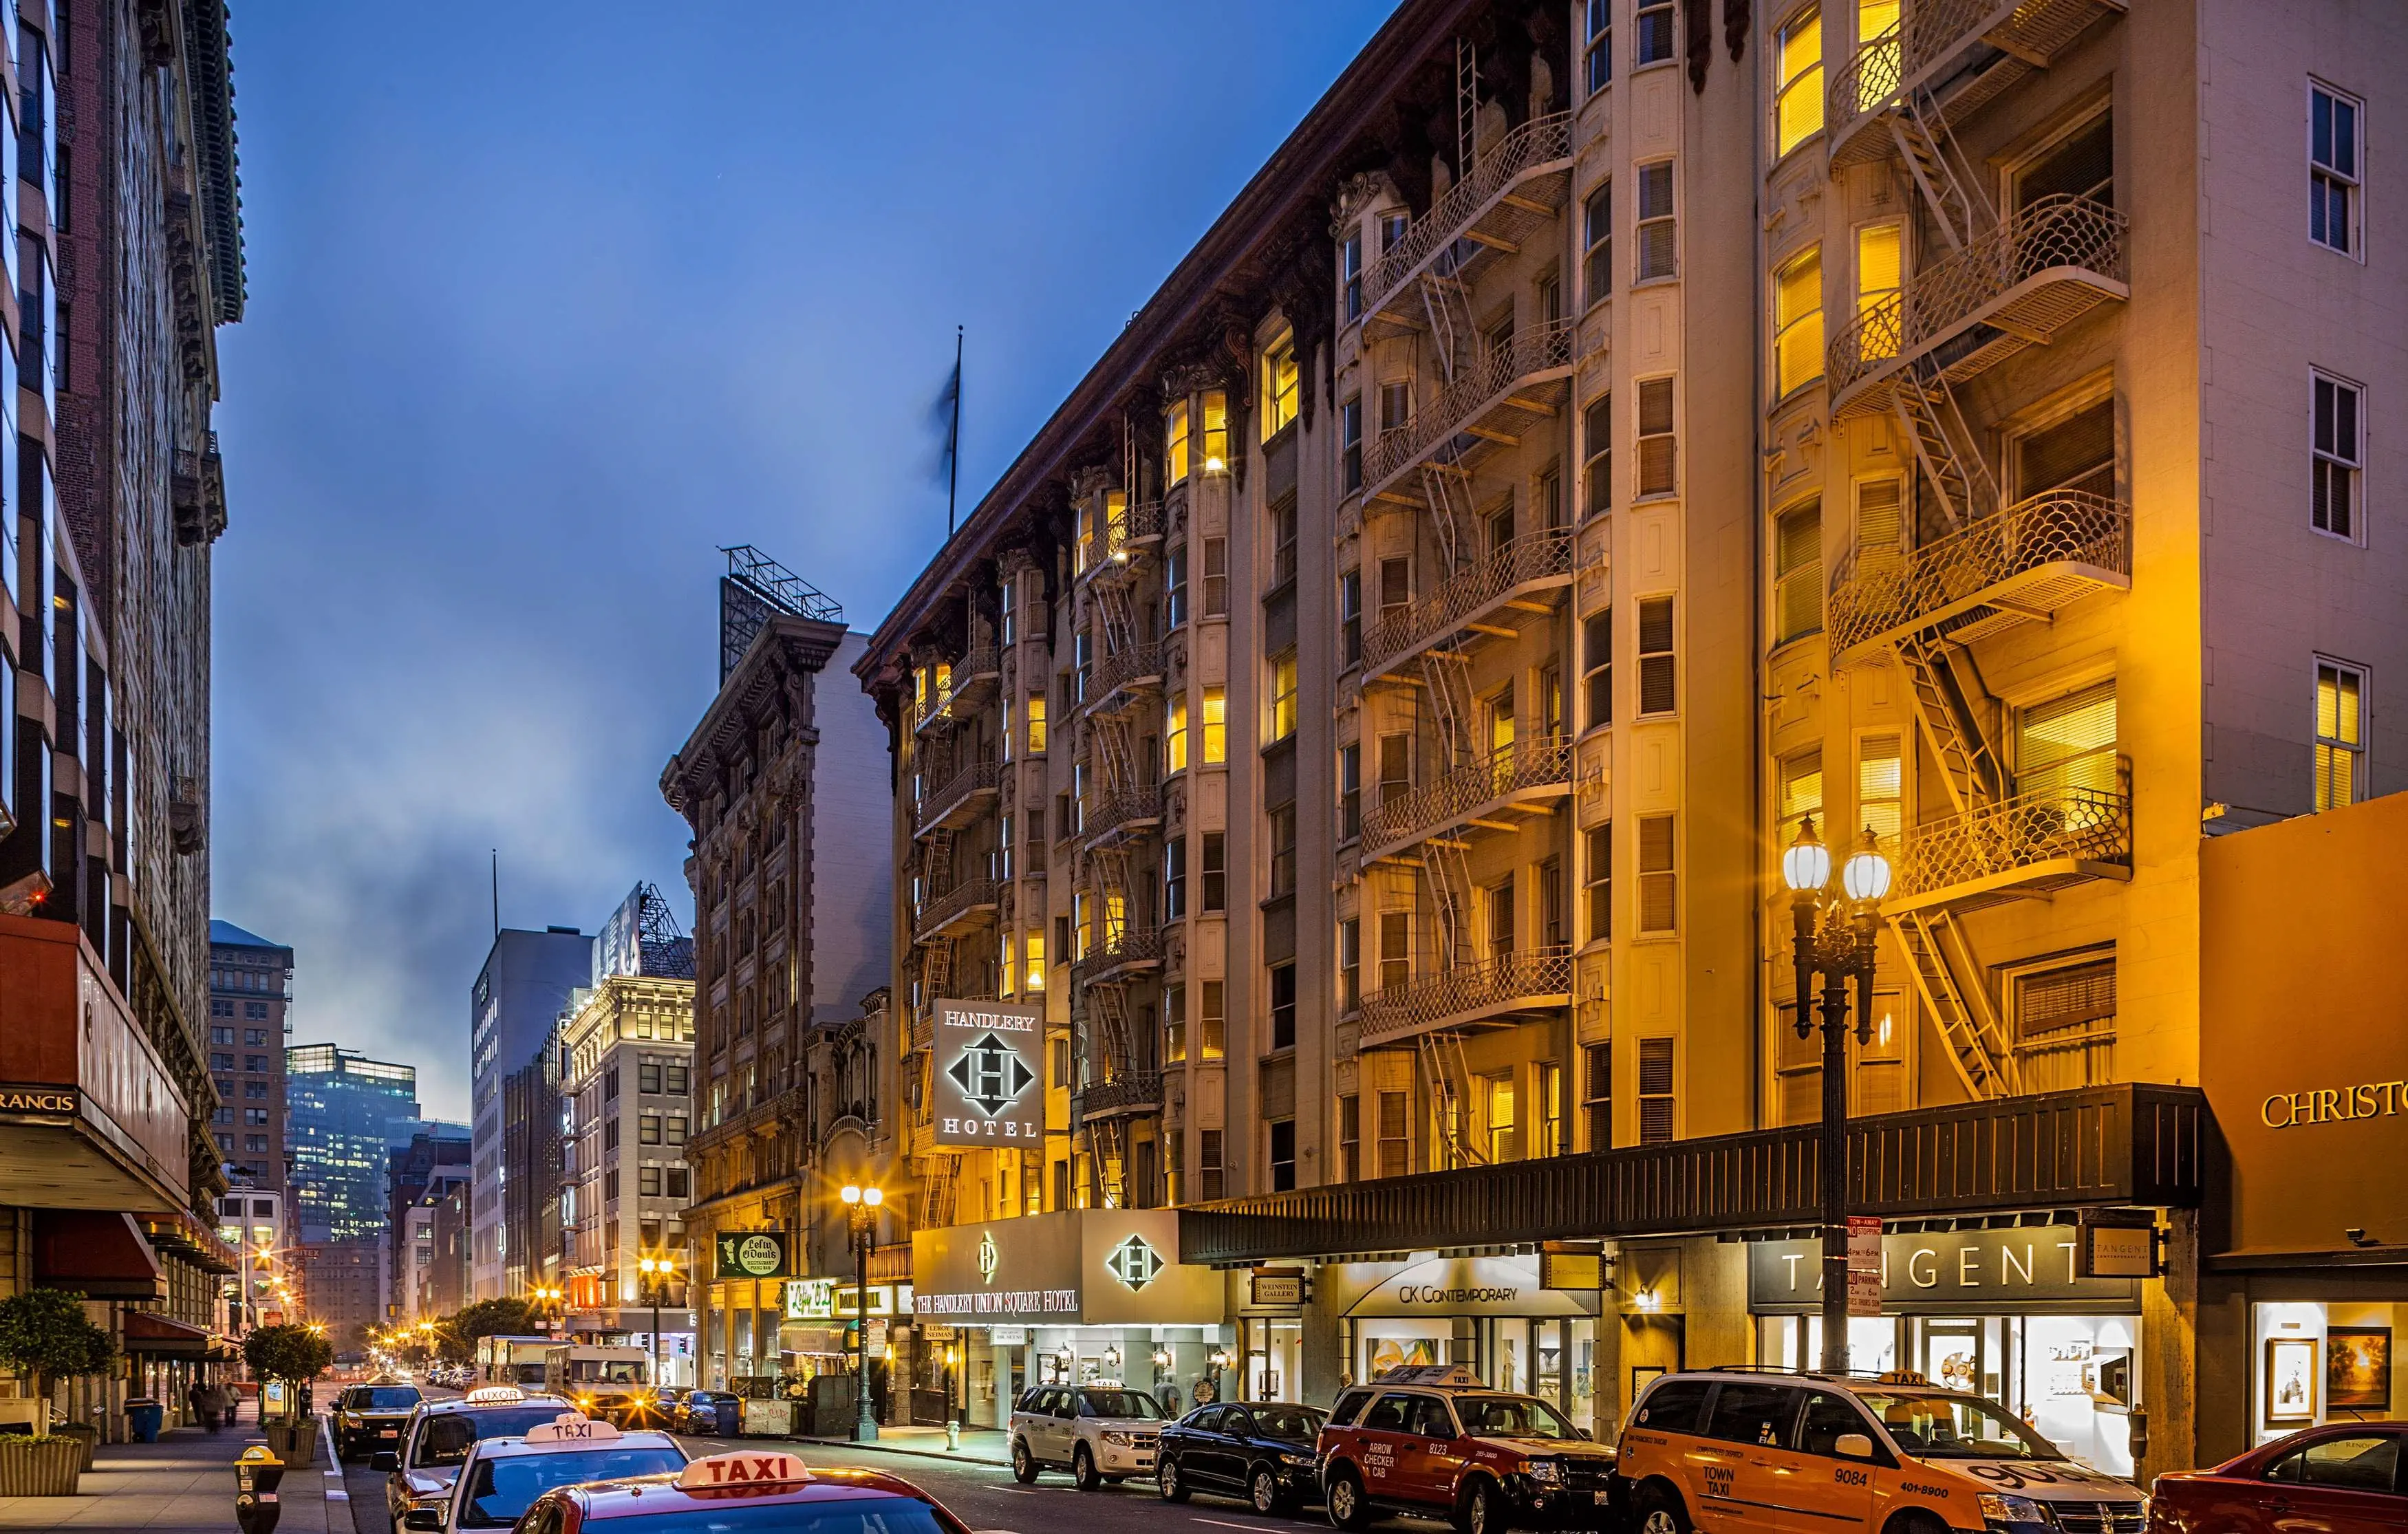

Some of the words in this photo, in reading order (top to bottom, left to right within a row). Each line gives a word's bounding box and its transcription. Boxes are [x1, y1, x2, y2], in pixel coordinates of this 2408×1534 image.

[944, 1011, 1035, 1032] HANDLERY
[943, 1119, 1036, 1137] HOTEL
[1847, 1226, 1856, 1235] NO
[2096, 1244, 2148, 1253] TANGENT
[1782, 1242, 2077, 1290] TGENT
[1847, 1272, 1856, 1284] NO
[1858, 1275, 1880, 1285] PARKING
[1399, 1286, 1419, 1303] CK
[1422, 1286, 1517, 1303] CONTEMPORARY
[916, 1295, 932, 1313] THE
[933, 1293, 973, 1313] HANDLERY
[974, 1293, 1003, 1313] UNION
[1005, 1290, 1040, 1317] SQUARE
[1043, 1290, 1078, 1312] HOTEL
[1892, 1374, 1923, 1385] TAXI
[475, 1391, 517, 1401] LUXOR
[552, 1424, 592, 1440] TAXI
[1369, 1443, 1393, 1454] ARROW
[1429, 1443, 1448, 1456] 8123
[1364, 1454, 1394, 1467] CHECKER
[707, 1458, 788, 1482] TAXI
[1373, 1467, 1386, 1478] CAB
[1703, 1466, 1734, 1482] TOWN
[1834, 1469, 1867, 1487] 9084
[1707, 1481, 1729, 1495] TAXI
[1901, 1482, 1948, 1498] 401-8900
